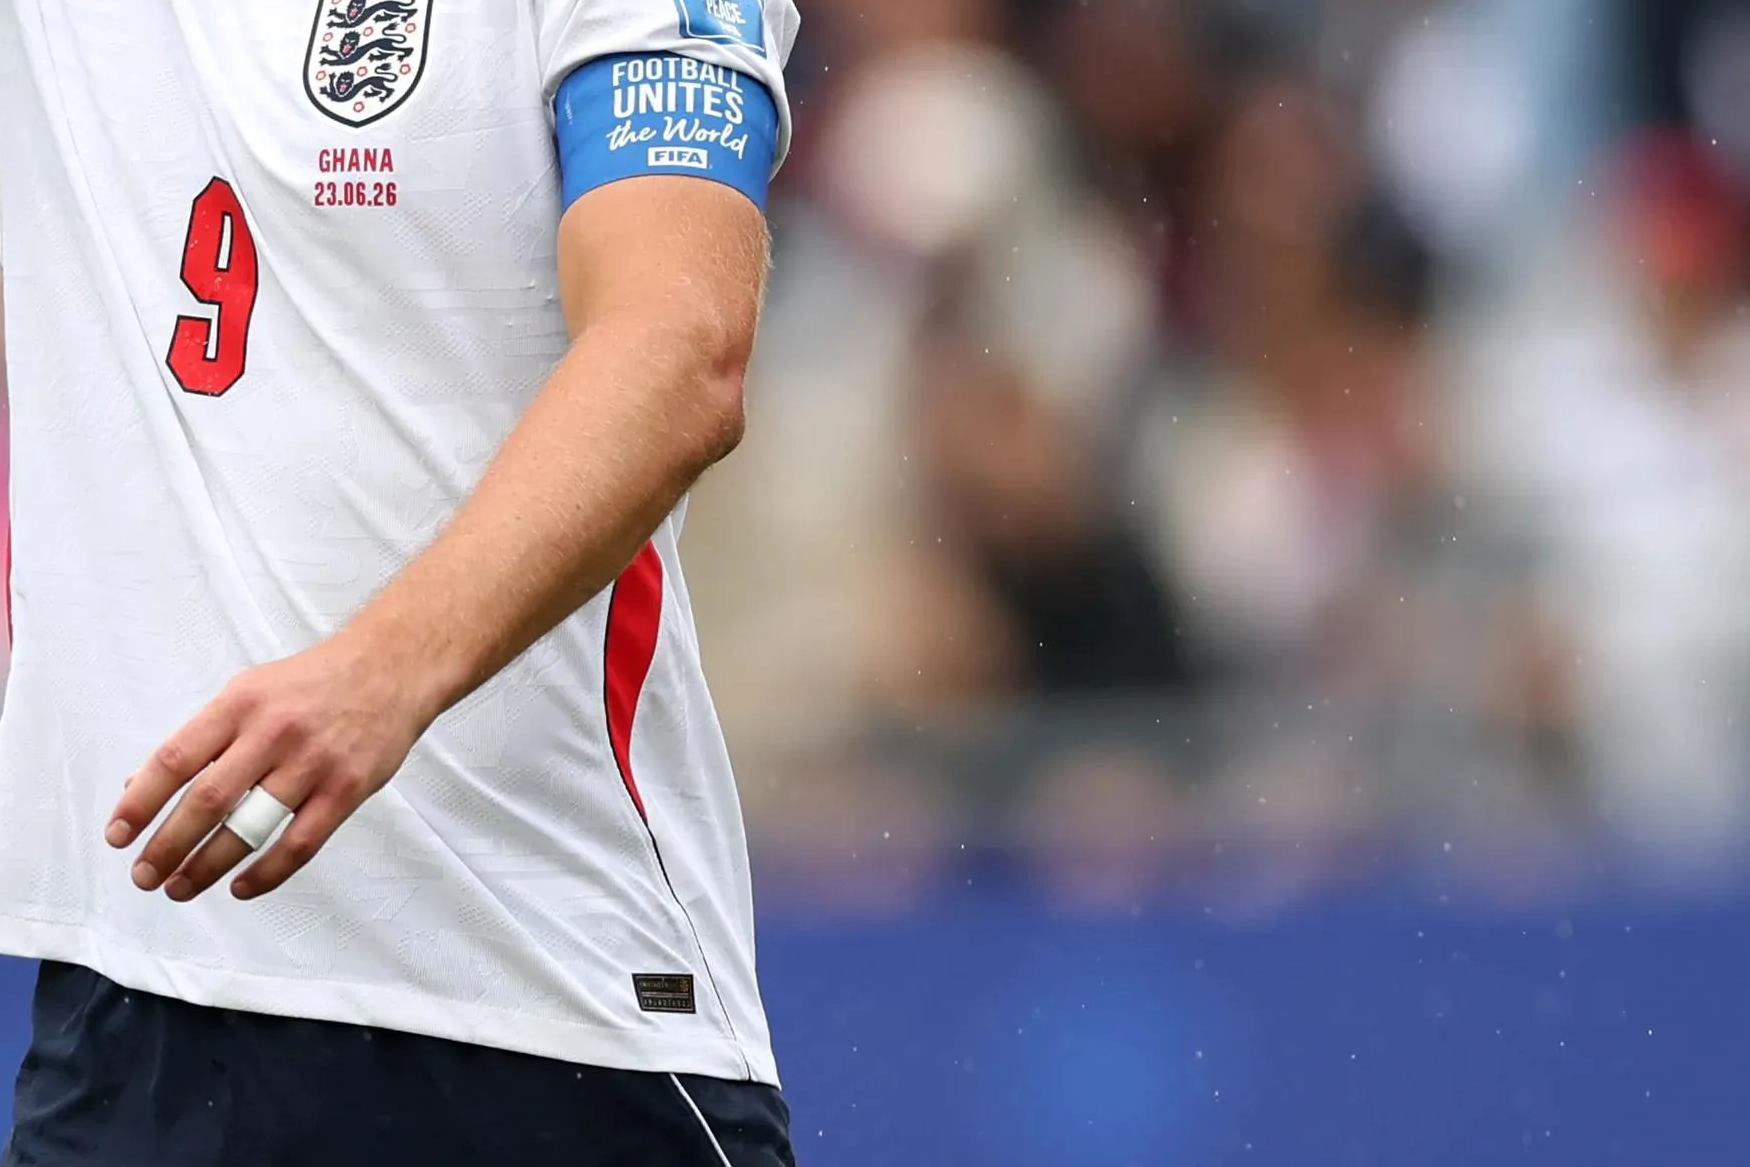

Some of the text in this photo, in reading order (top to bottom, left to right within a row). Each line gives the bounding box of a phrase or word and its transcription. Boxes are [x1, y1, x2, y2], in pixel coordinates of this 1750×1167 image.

[612, 57, 744, 93] FOOTBALL
[613, 81, 744, 125] UNITES
[606, 116, 749, 160] the World
[318, 147, 394, 173] GHANA
[654, 150, 703, 165] FIFA
[314, 181, 397, 207] 23.06.26
[165, 175, 259, 398] 9
